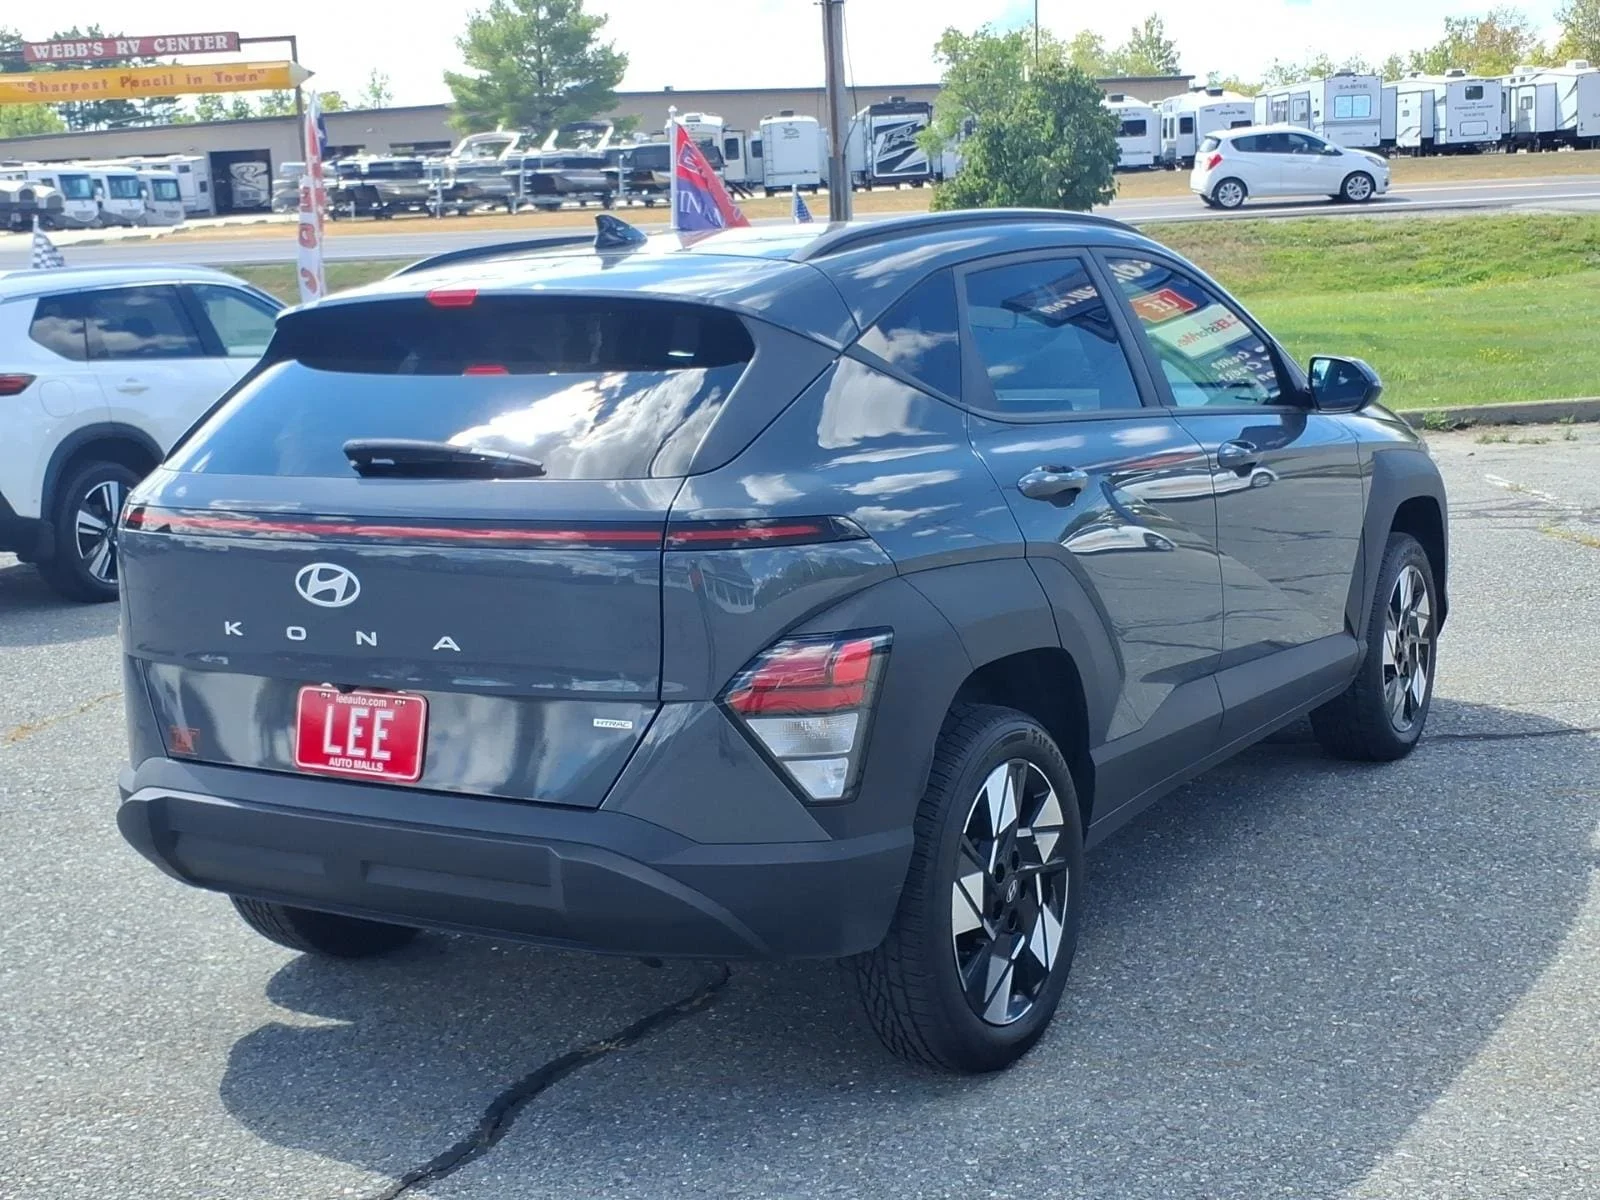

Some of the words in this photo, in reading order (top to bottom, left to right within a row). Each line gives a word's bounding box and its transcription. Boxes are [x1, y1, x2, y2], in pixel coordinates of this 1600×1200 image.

[31, 41, 104, 59] WEBB'S
[115, 39, 140, 55] RV
[153, 35, 228, 52] CENTER
[119, 72, 175, 89] Pencil
[186, 73, 203, 85] in
[224, 620, 461, 652] KONA
[335, 693, 387, 707] leeauto.com
[322, 703, 395, 761] LEE
[328, 757, 353, 768] AUTO
[353, 759, 384, 772] MALLS
